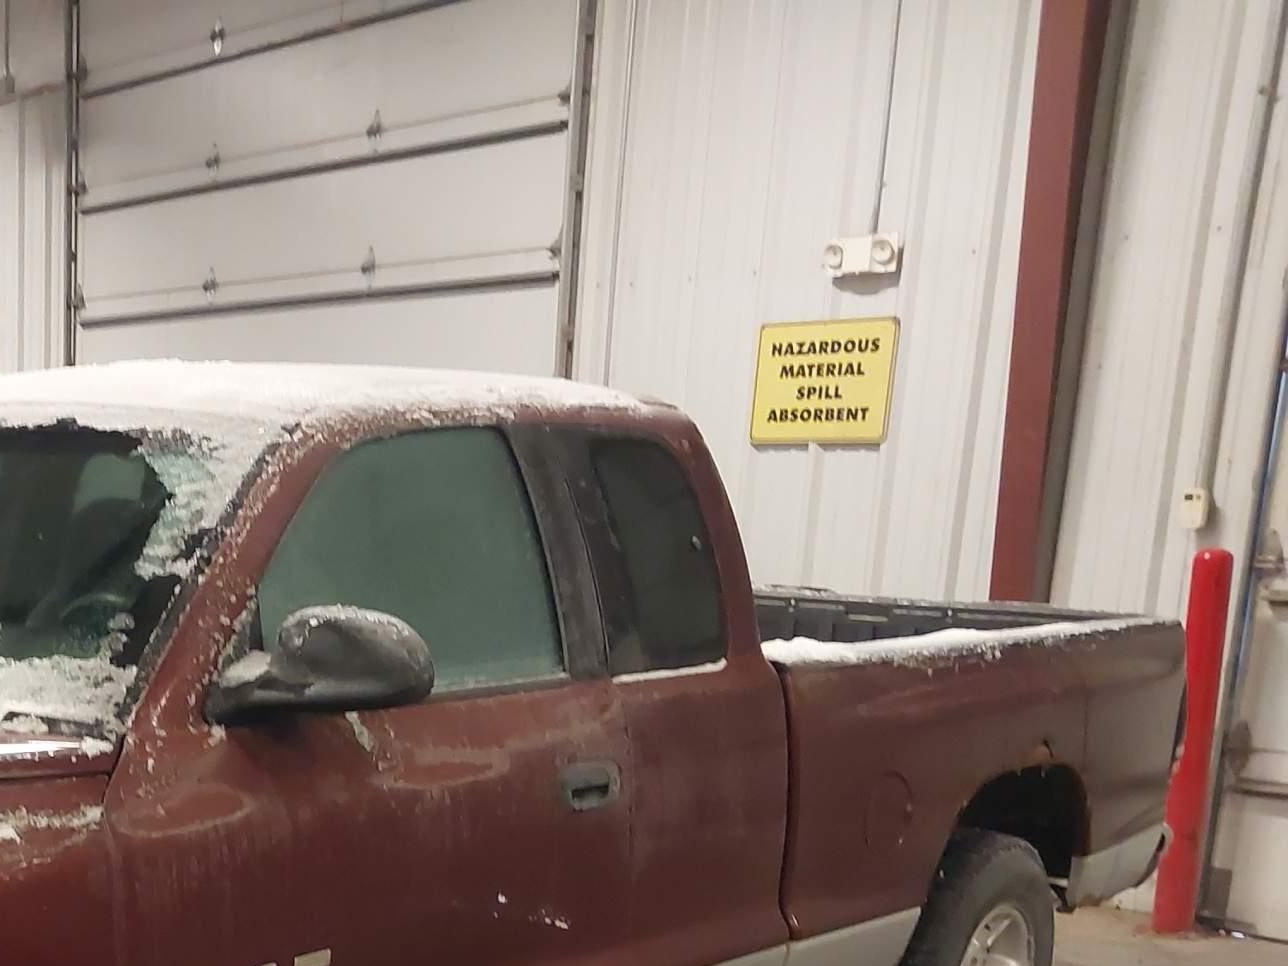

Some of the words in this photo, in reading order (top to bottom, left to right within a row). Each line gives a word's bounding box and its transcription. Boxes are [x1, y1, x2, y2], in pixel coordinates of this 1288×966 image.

[771, 338, 880, 357] HAZARDOUS
[779, 361, 865, 379] MATERIAL
[795, 385, 842, 400] SPILL
[767, 407, 869, 423] ABSORBENT
